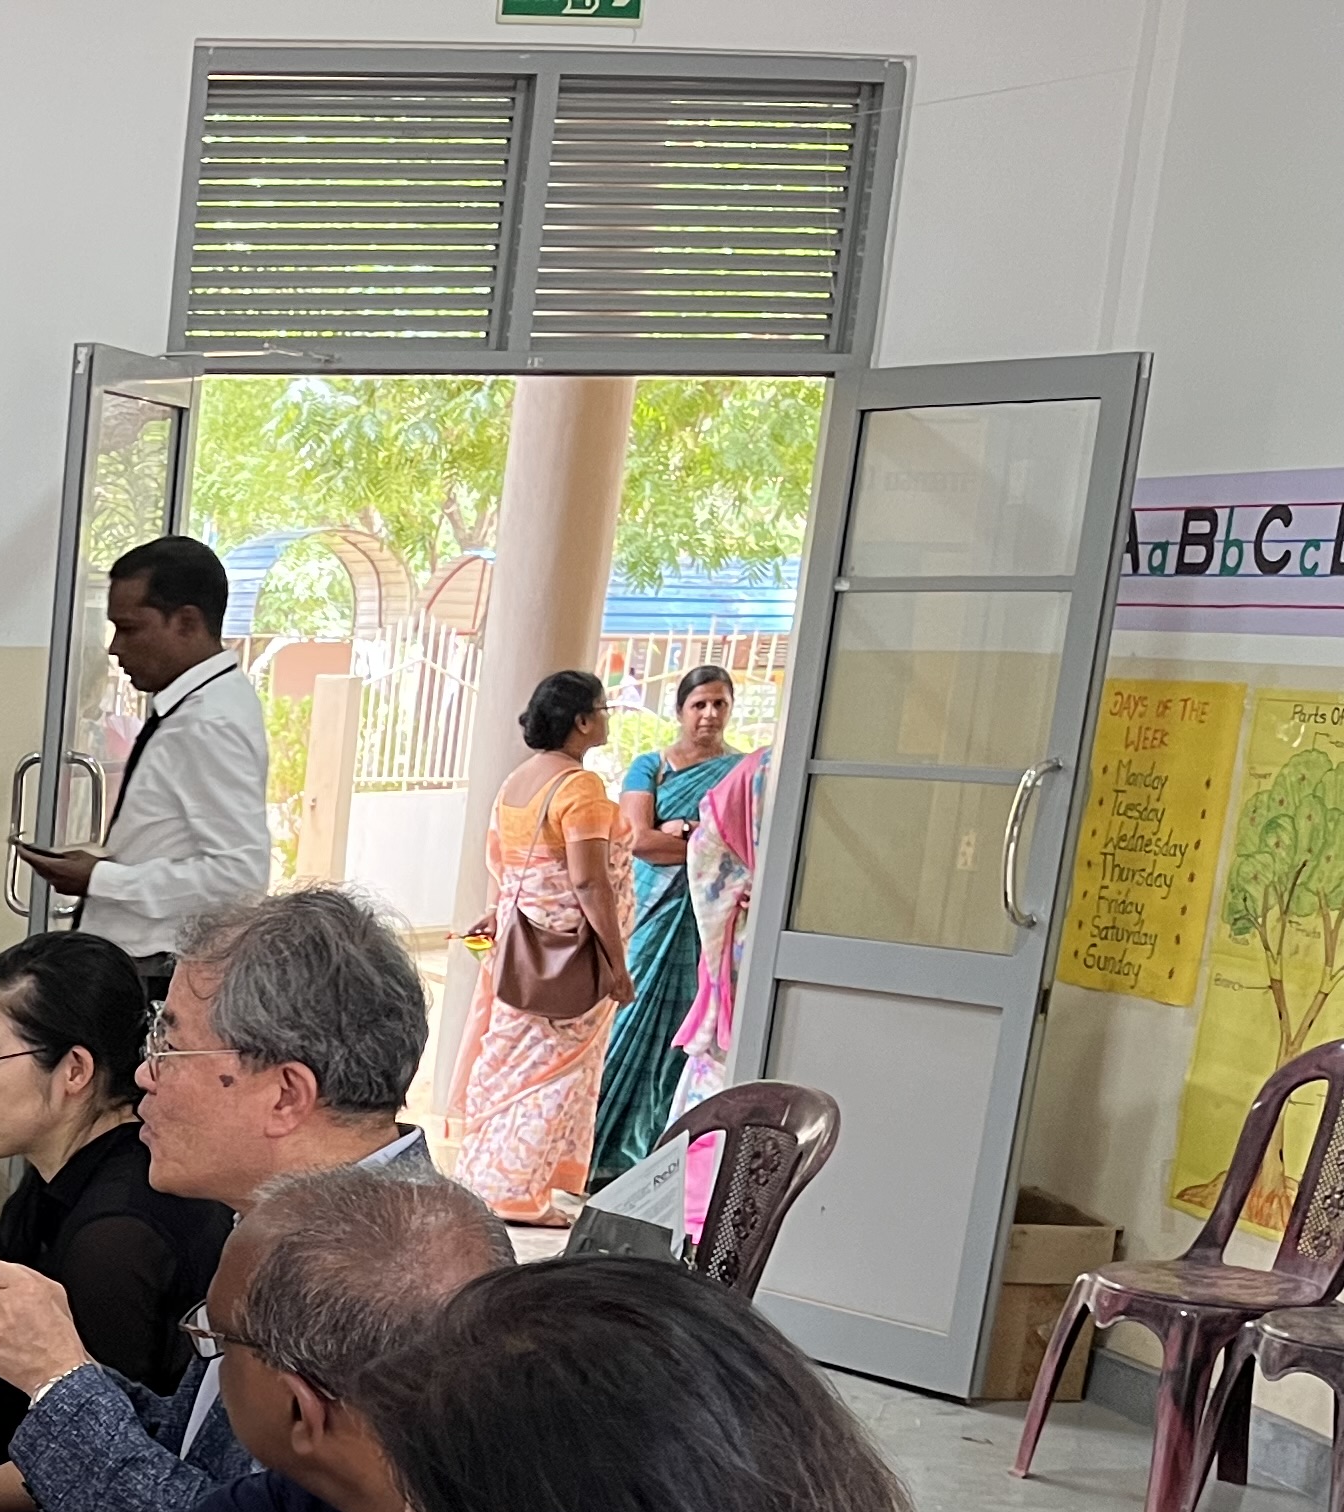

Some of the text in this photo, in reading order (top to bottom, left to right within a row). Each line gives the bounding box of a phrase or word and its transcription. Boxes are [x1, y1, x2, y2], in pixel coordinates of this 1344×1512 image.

[1179, 697, 1210, 724] THE
[1291, 703, 1327, 724] Parts
[1124, 725, 1170, 752] WEEK
[1115, 758, 1169, 802] Monday
[1111, 789, 1166, 835] Tuesday
[1104, 820, 1189, 869] Wednesday
[1100, 852, 1175, 900] Thursday
[1096, 885, 1145, 926] Friday
[1090, 915, 1158, 959] Saturday
[1083, 943, 1142, 989] Sunday
